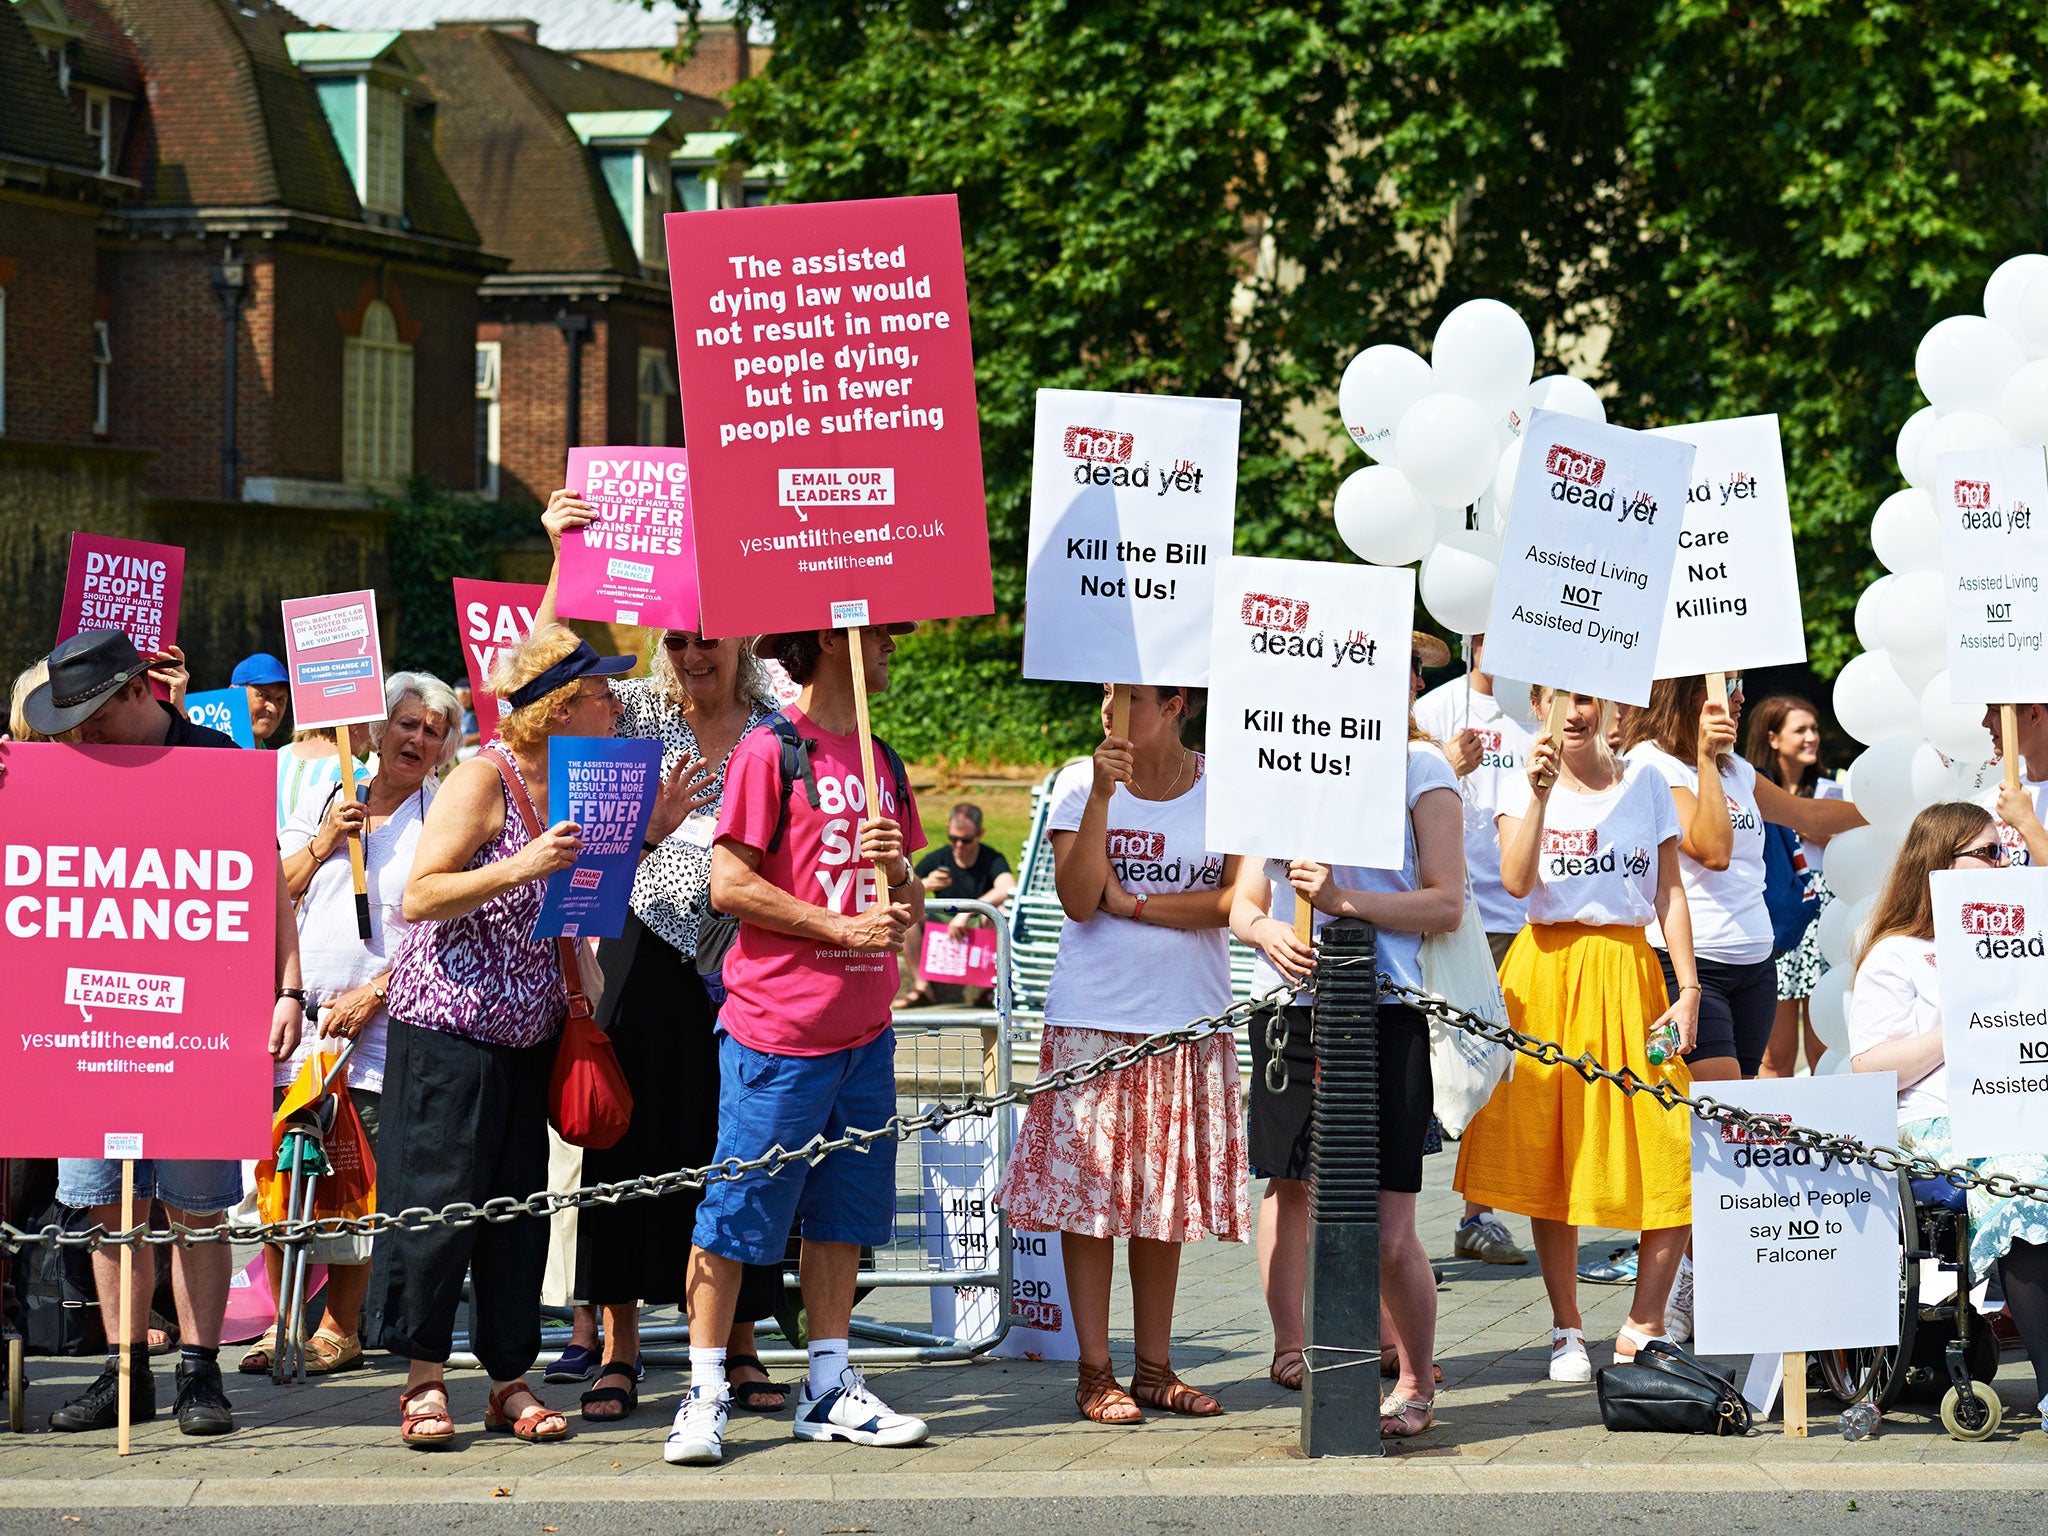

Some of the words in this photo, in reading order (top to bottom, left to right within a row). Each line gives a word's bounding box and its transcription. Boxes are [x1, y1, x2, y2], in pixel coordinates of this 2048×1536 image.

[729, 255, 782, 279] The
[791, 245, 905, 275] assisted
[709, 287, 786, 317] dying
[796, 284, 841, 307] law
[851, 275, 931, 302] would
[696, 321, 742, 346] not
[753, 314, 835, 342] result
[844, 311, 870, 336] in
[880, 311, 950, 333] more
[734, 348, 824, 382] people
[834, 342, 919, 373] dying,
[745, 384, 792, 408] but
[802, 379, 829, 403] in
[838, 376, 913, 400] fewer
[720, 413, 810, 447] people
[820, 403, 945, 434] suffering
[1070, 429, 1130, 463] not
[587, 460, 687, 483] DYING
[1174, 458, 1195, 473] UK
[1550, 448, 1603, 486] not
[791, 473, 842, 486] EMAIL
[847, 472, 881, 485] OUR
[1074, 458, 1149, 488] dead
[1157, 468, 1204, 496] yet
[1730, 471, 1749, 484] UK
[586, 478, 686, 501] PEOPLE
[786, 489, 861, 502] LEADERS
[867, 489, 887, 501] AT
[1634, 490, 1653, 505] UK
[1719, 477, 1758, 506] yet
[1956, 481, 1988, 508] not
[585, 494, 623, 504] SHOULD
[624, 497, 643, 506] NOT
[645, 499, 670, 508] HAVE
[672, 501, 684, 509] TO
[1550, 477, 1616, 512] dead
[1617, 496, 1658, 525] yet
[590, 503, 684, 527] SUFFER
[1961, 505, 2002, 530] dead
[2006, 507, 2031, 534] yet
[584, 522, 643, 534] AGAINST
[645, 525, 683, 538] THEIR
[739, 519, 945, 557] yesuntiltheend.co.uk
[1678, 529, 1729, 549] Care
[583, 530, 682, 556] WISHES
[1066, 538, 1108, 560] Kill
[1116, 541, 1156, 563] the
[1166, 543, 1207, 565] Bill
[86, 552, 166, 582] DYING
[611, 561, 651, 574] DEMAND
[797, 552, 893, 573] #untiltheend
[1525, 544, 1597, 576] Assisted
[1600, 561, 1649, 590] Living
[1688, 562, 1728, 582] Not
[610, 568, 649, 581] CHANGE
[1958, 575, 2003, 591] Assisted
[2005, 573, 2039, 592] Living
[83, 574, 165, 601] PEOPLE
[1080, 575, 1126, 597] Not
[1134, 578, 1176, 600] Us!
[1562, 583, 1603, 608] NOT
[83, 592, 114, 602] SHOULD
[115, 596, 130, 604] NOT
[132, 599, 152, 607] HAVE
[834, 606, 863, 614] DIGNITY
[1676, 596, 1748, 618] Killing
[80, 600, 163, 625] SUFFER
[311, 615, 332, 625] WANT
[333, 611, 347, 619] THE
[348, 608, 364, 616] LAW
[1246, 594, 1305, 632] not
[1986, 603, 2012, 620] NOT
[78, 617, 127, 630] AGAINST
[130, 623, 161, 635] THEIR
[296, 626, 306, 634] ON
[308, 620, 341, 631] ASSISTED
[342, 614, 364, 624] DYING
[1511, 604, 1583, 635] Assisted
[1587, 620, 1639, 650] Dying!
[301, 639, 314, 647] ARE
[316, 636, 331, 644] YOU
[332, 632, 350, 641] WITH
[1251, 626, 1324, 659] dead
[1332, 639, 1377, 668] yet
[1348, 630, 1369, 644] UK
[1960, 633, 2005, 649] Assisted
[2008, 632, 2043, 652] Dying!
[301, 665, 330, 674] DEMAND
[331, 662, 359, 670] CHANGE
[1244, 708, 1283, 733] Kill
[1292, 714, 1331, 737] the
[1340, 717, 1381, 741] Bill
[1258, 747, 1302, 772] Not
[1310, 752, 1351, 776] Us!
[1481, 749, 1514, 769] ead
[568, 768, 618, 782] WOULD
[621, 769, 646, 782] NOT
[569, 782, 606, 792] RESULT
[608, 782, 618, 792] IN
[620, 783, 644, 793] MORE
[569, 800, 641, 822] FEWER
[1108, 831, 1160, 859] not
[1545, 831, 1592, 855] not
[5, 844, 254, 891] DEMAND
[1114, 857, 1181, 882] dead
[1185, 864, 1221, 889] yet
[1204, 855, 1220, 869] UK
[1550, 847, 1616, 876] dead
[1623, 853, 1651, 878] yet
[572, 878, 598, 887] CHANGE
[575, 870, 601, 879] DEMAND
[5, 895, 250, 942] CHANGE
[1967, 905, 2020, 934] not
[1975, 931, 2045, 960] dead
[80, 973, 131, 989] EMAIL
[137, 978, 171, 992] OUR
[73, 989, 149, 1006] LEADERS
[154, 996, 175, 1009] AT
[1969, 1008, 2047, 1029] Assisted
[20, 1030, 230, 1051] yesuntiltheend.co.uk
[77, 1059, 174, 1073] #untiltheend
[1972, 1074, 2048, 1095] Assisted
[1733, 1142, 1810, 1168] dead
[1720, 1192, 1800, 1210] Disabled
[1807, 1188, 1872, 1209] People
[1750, 1225, 1782, 1241] say
[1788, 1220, 1819, 1238] NO
[1825, 1220, 1842, 1234] to
[1756, 1247, 1837, 1263] Falconer
